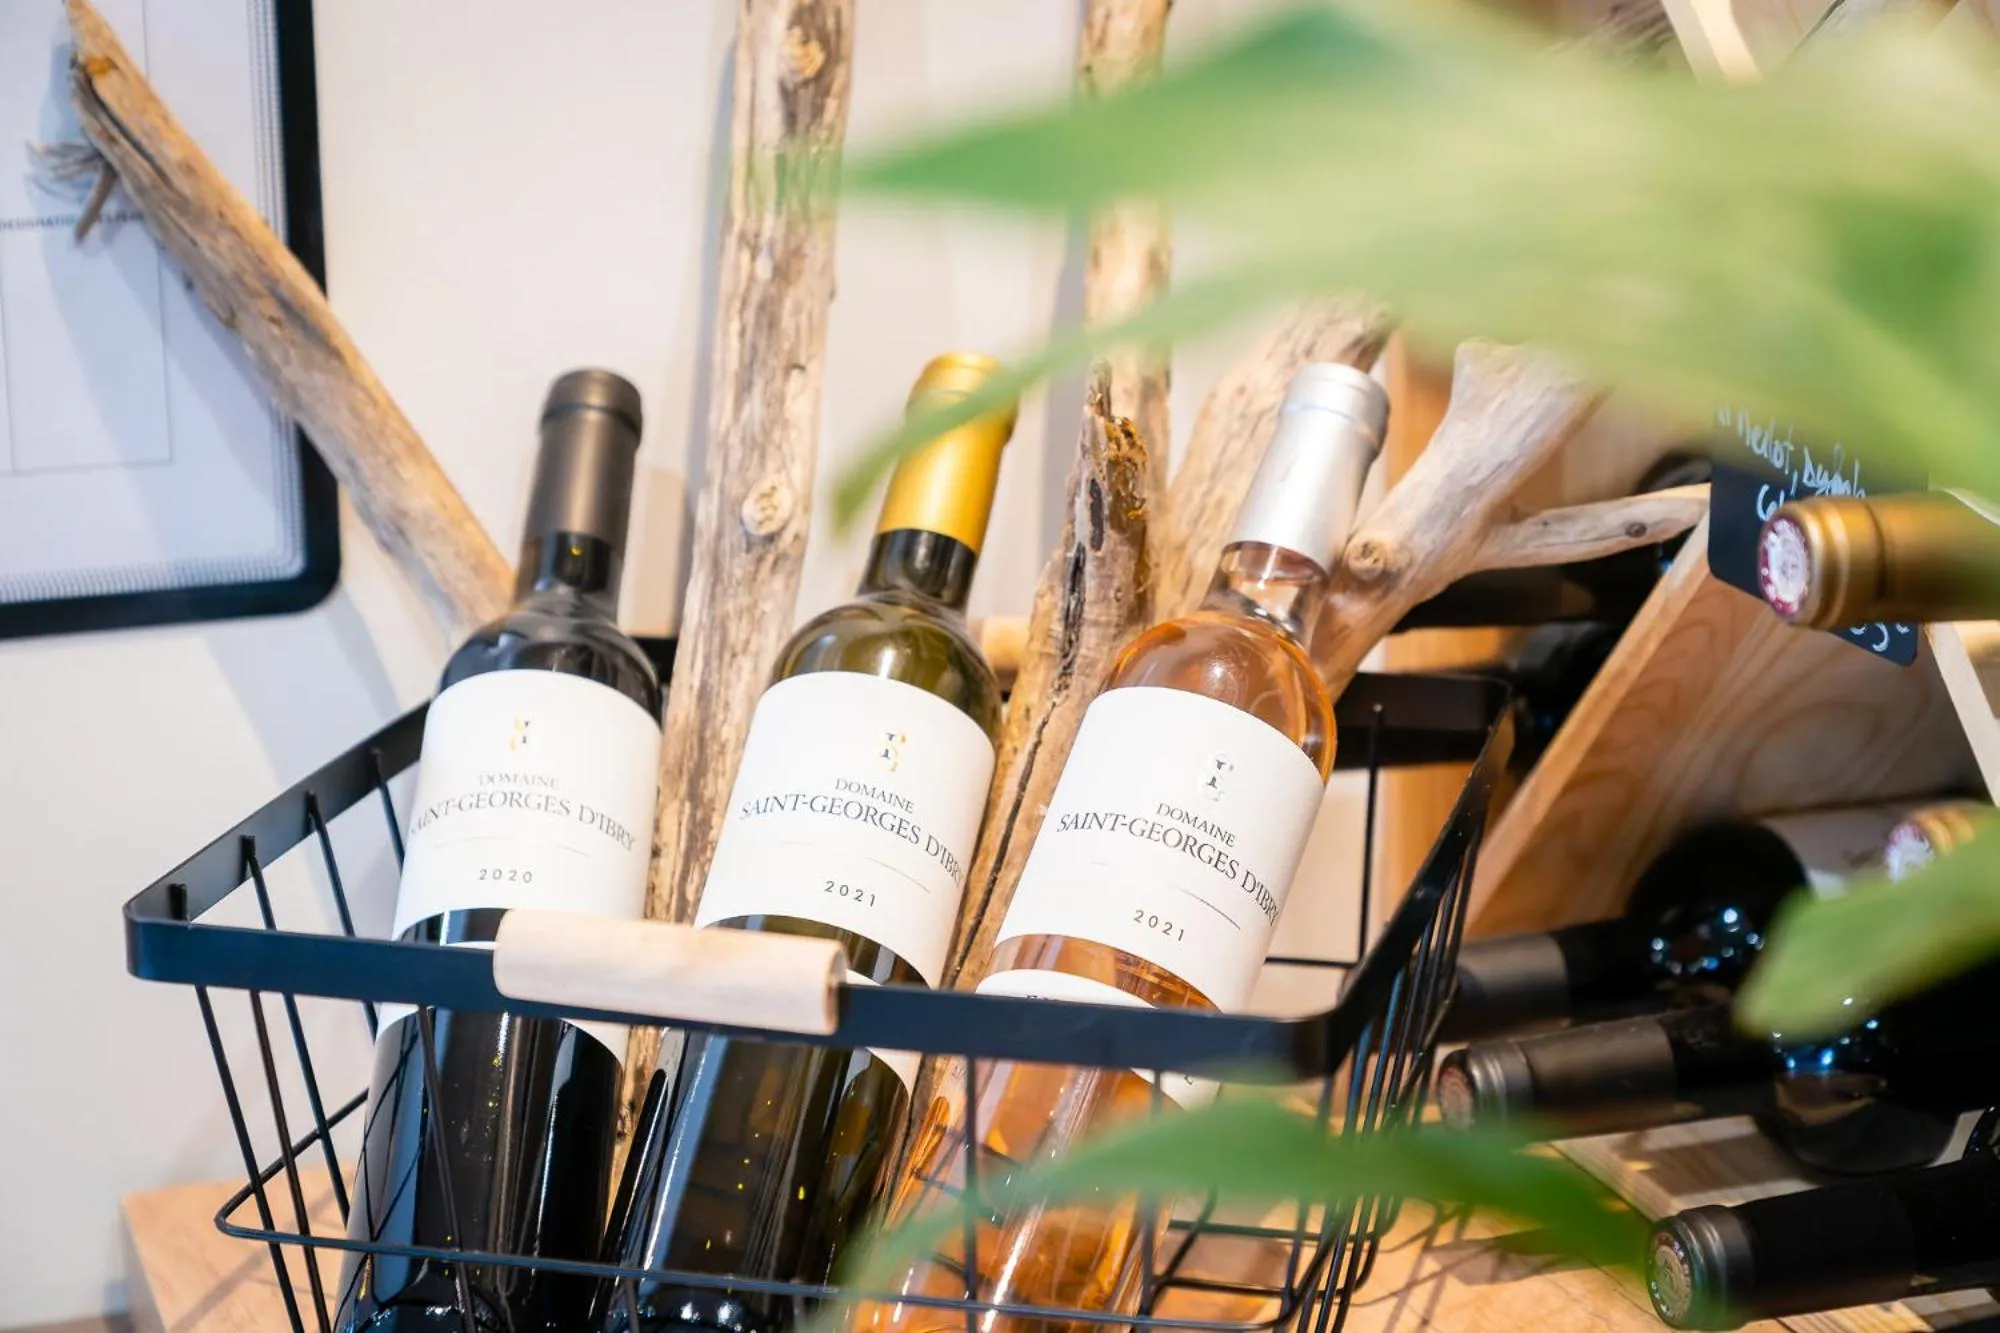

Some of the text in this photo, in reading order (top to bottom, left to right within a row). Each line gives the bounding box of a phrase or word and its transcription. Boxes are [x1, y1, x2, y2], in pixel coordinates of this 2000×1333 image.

[478, 772, 558, 790] DOMAINE
[834, 777, 915, 815] DOMAINE
[578, 803, 637, 852] D'IBRY
[738, 793, 922, 846] SAINT-GEORGES
[1155, 802, 1236, 848] DOMAINE
[478, 868, 534, 884] 2020
[1056, 811, 1280, 927] SAINT-GEORGES D'IBRY
[824, 880, 877, 908] 2021
[1133, 909, 1185, 942] 2021
